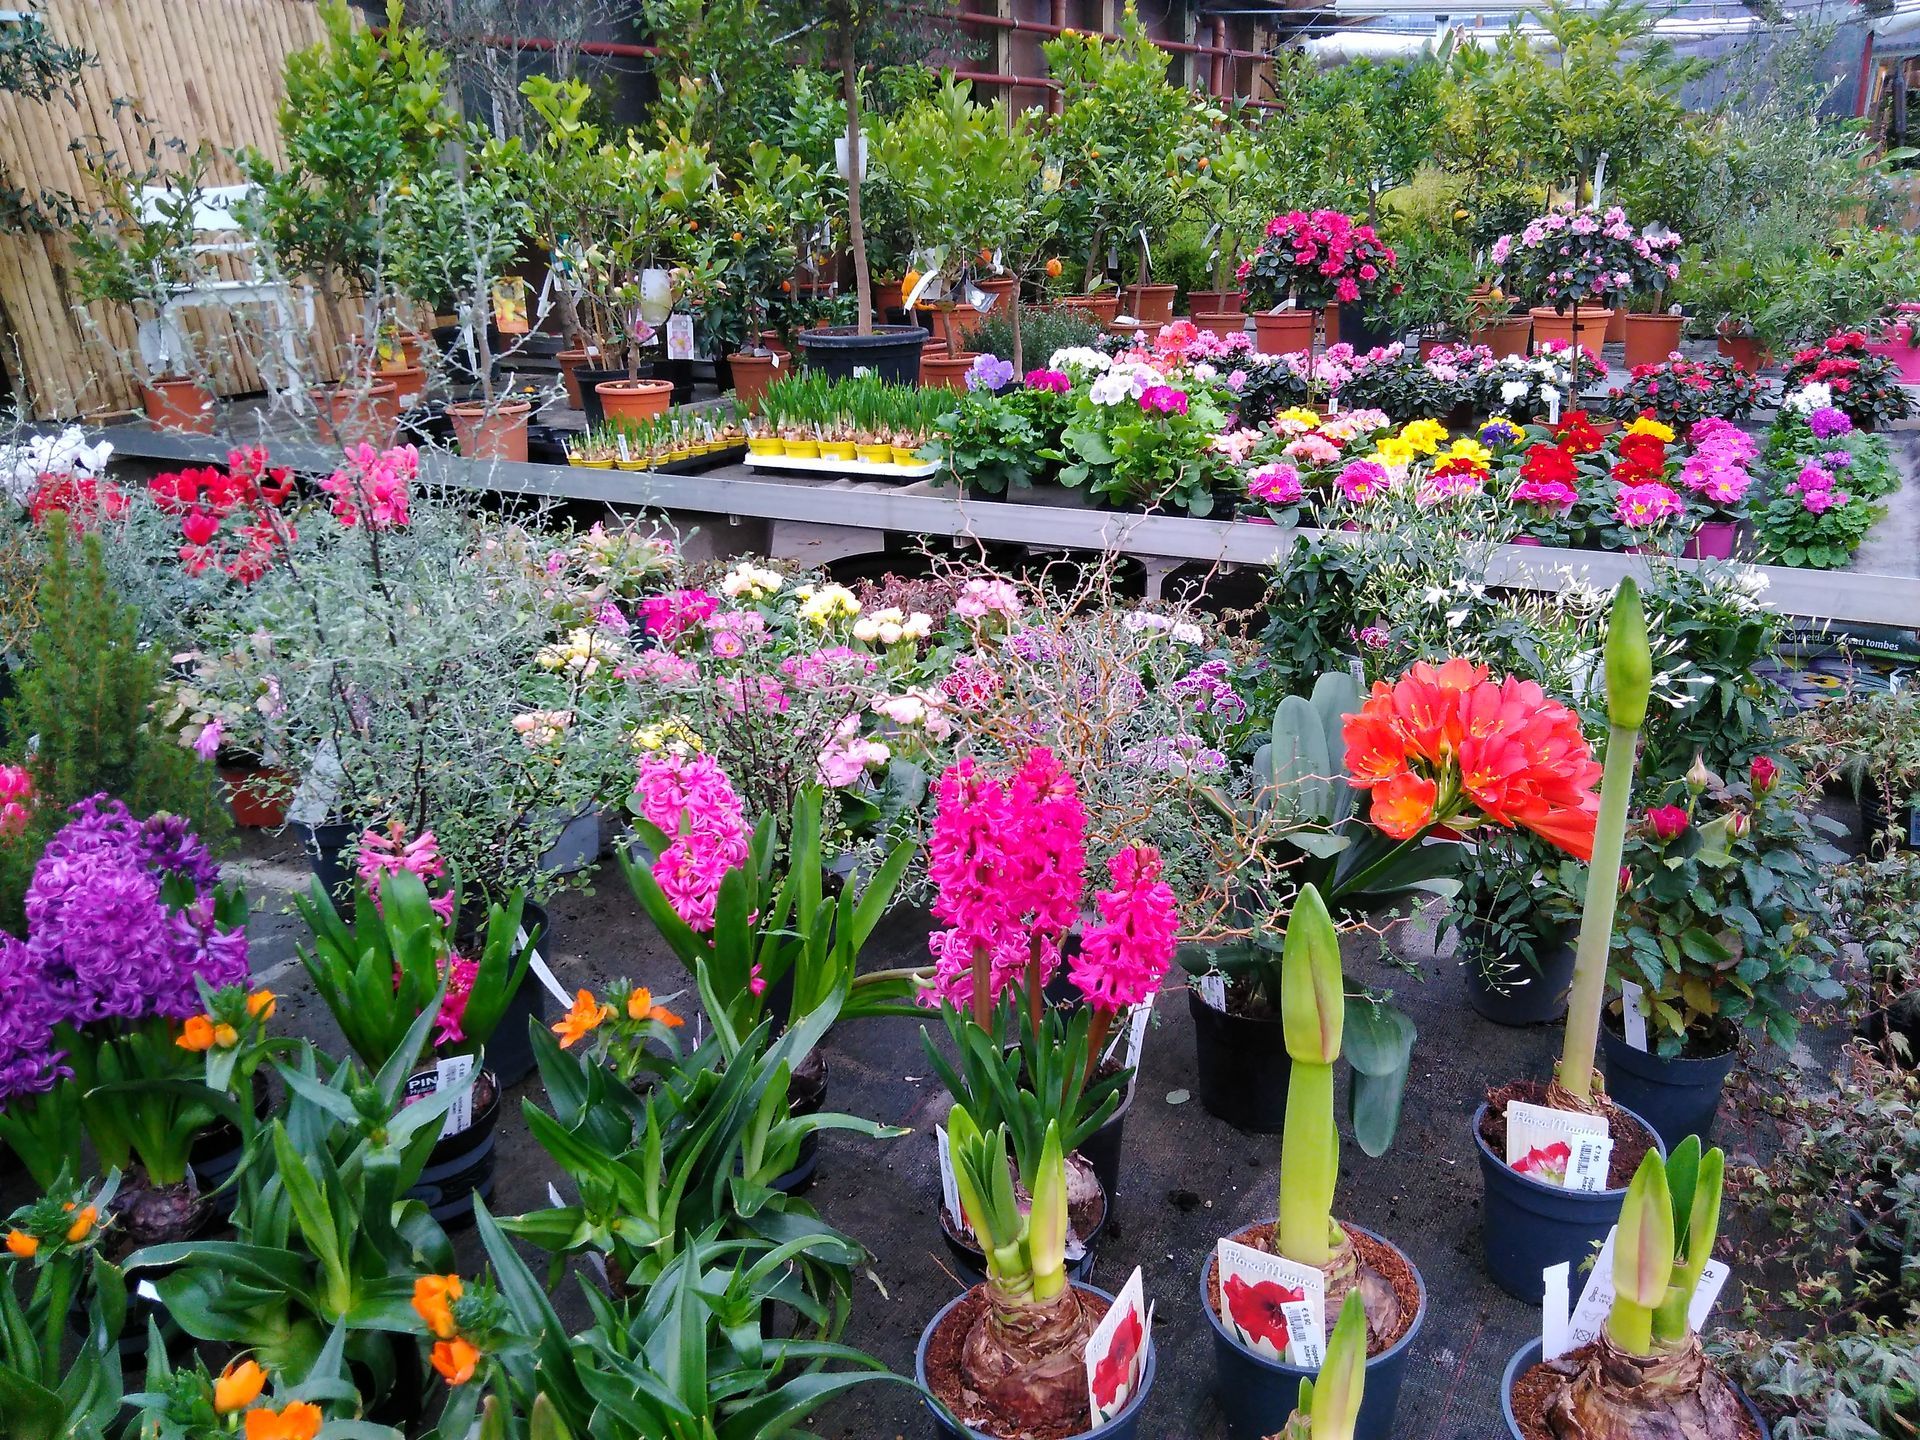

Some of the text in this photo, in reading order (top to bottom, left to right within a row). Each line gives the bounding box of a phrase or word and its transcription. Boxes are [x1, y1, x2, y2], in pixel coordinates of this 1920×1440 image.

[1866, 639, 1899, 650] tombes
[409, 1076, 438, 1089] PIN
[1225, 1248, 1319, 1290] Flora Magica
